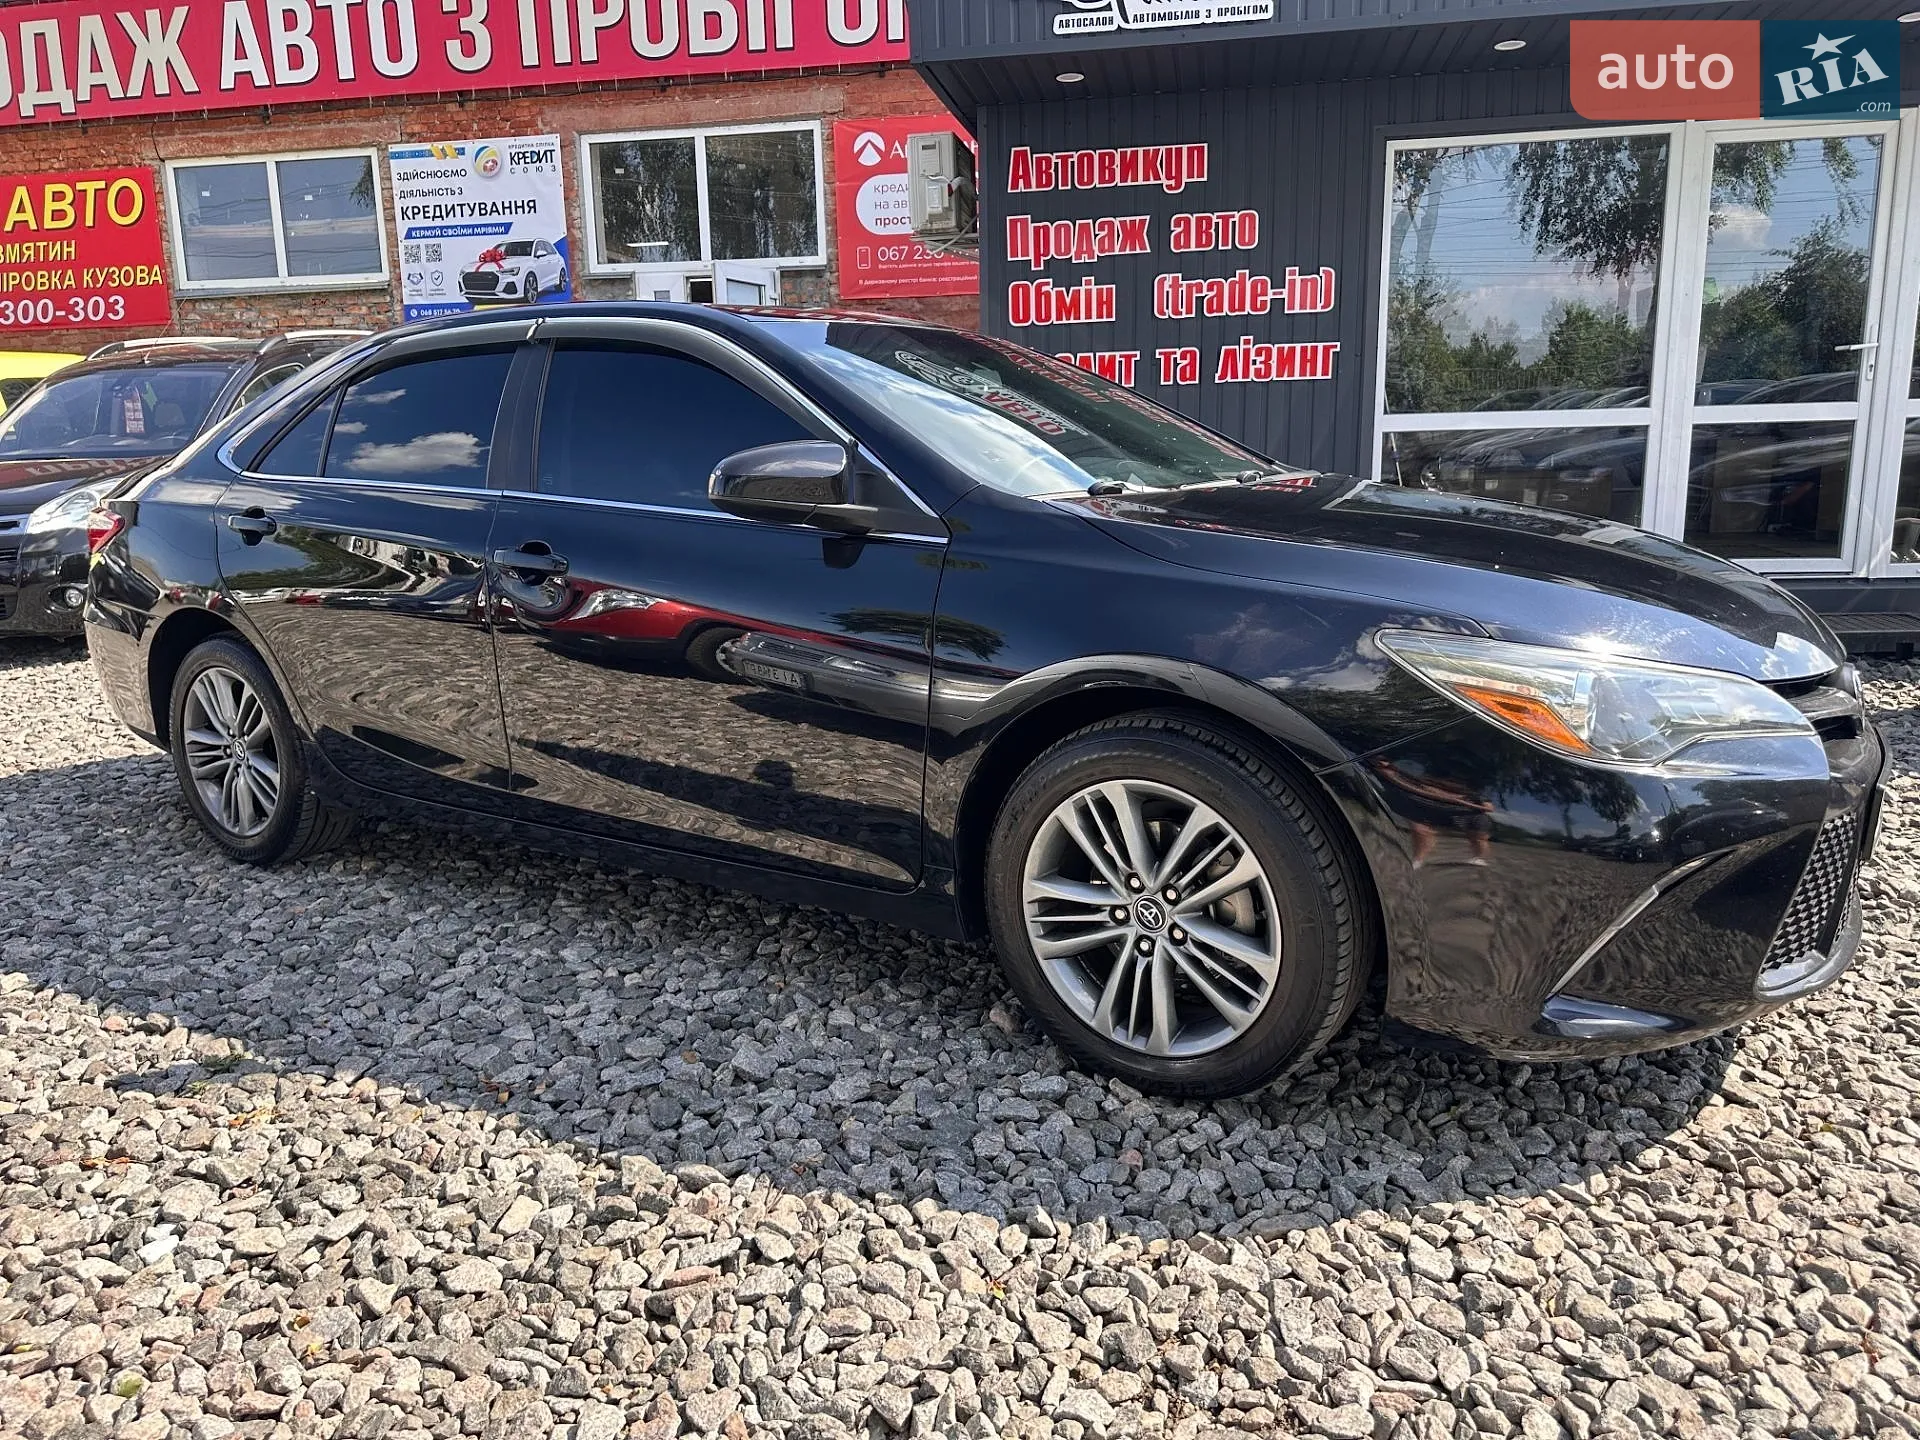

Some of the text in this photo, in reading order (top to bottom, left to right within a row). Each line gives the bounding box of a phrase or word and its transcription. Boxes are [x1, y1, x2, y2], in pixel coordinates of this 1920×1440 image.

[1058, 4, 1269, 30] АВТОСАЛОН АВТОМОБІЛІВ З ПРОБІГОМ
[219, 0, 419, 91] АВТО
[396, 168, 468, 182] ЗДІЙСНЮЄМО
[1007, 143, 1208, 194] Автовикуп
[4, 177, 143, 232] АВТО
[399, 187, 457, 200] ДІЯЛЬНІСТЬ
[874, 200, 908, 210] на ав
[400, 199, 538, 222] КРЕДИТУВАННЯ
[874, 215, 912, 228] прост
[411, 225, 505, 238] КЕРМУЙ СВОЇМИ МРІЯМИ
[1006, 210, 1260, 270] Продаж авто
[877, 246, 908, 261] 067
[0, 264, 164, 293] ІРОВКА КУЗОВА
[0, 295, 125, 326] 300-303
[1008, 267, 1336, 327] Обмін (trade-in)
[1054, 349, 1142, 388] дит
[1155, 347, 1200, 386] та
[1215, 336, 1340, 384] лізинг
